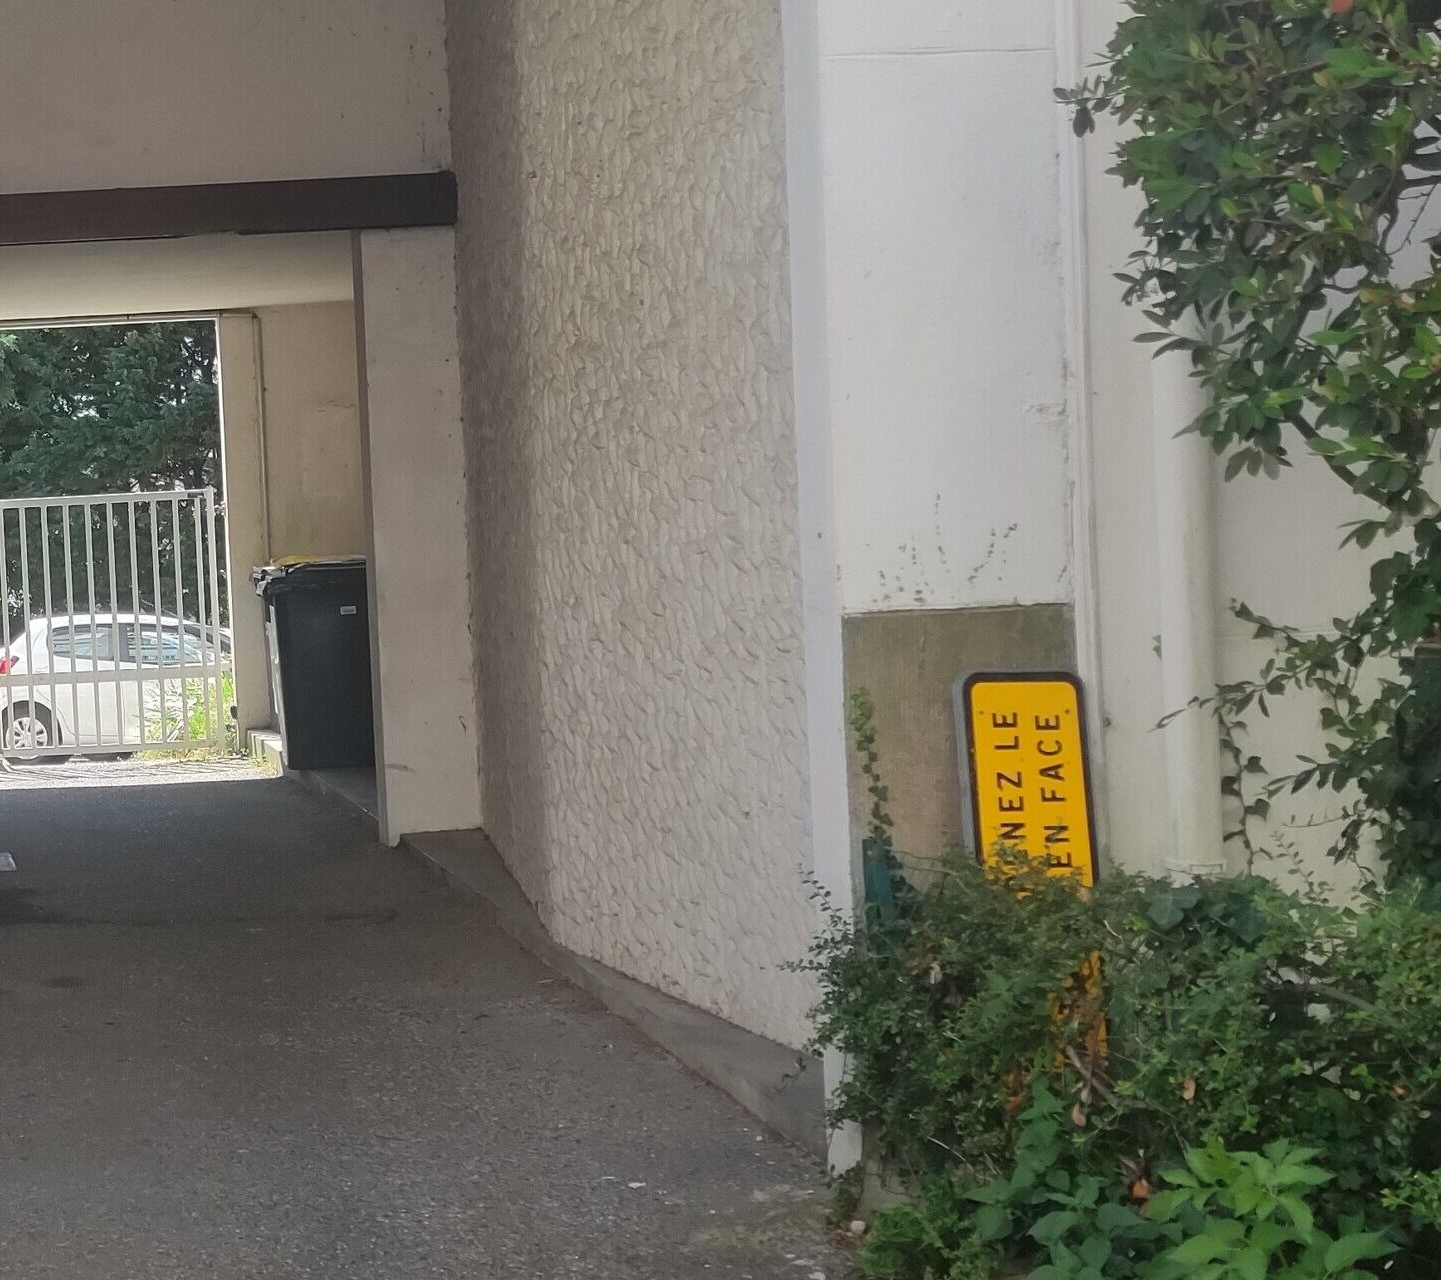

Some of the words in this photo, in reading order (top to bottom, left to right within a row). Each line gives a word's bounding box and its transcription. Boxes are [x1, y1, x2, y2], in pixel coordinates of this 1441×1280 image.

[992, 712, 1020, 750] LE
[1035, 715, 1066, 802] FACE
[996, 771, 1027, 865] NEZ
[1043, 825, 1072, 868] EN
